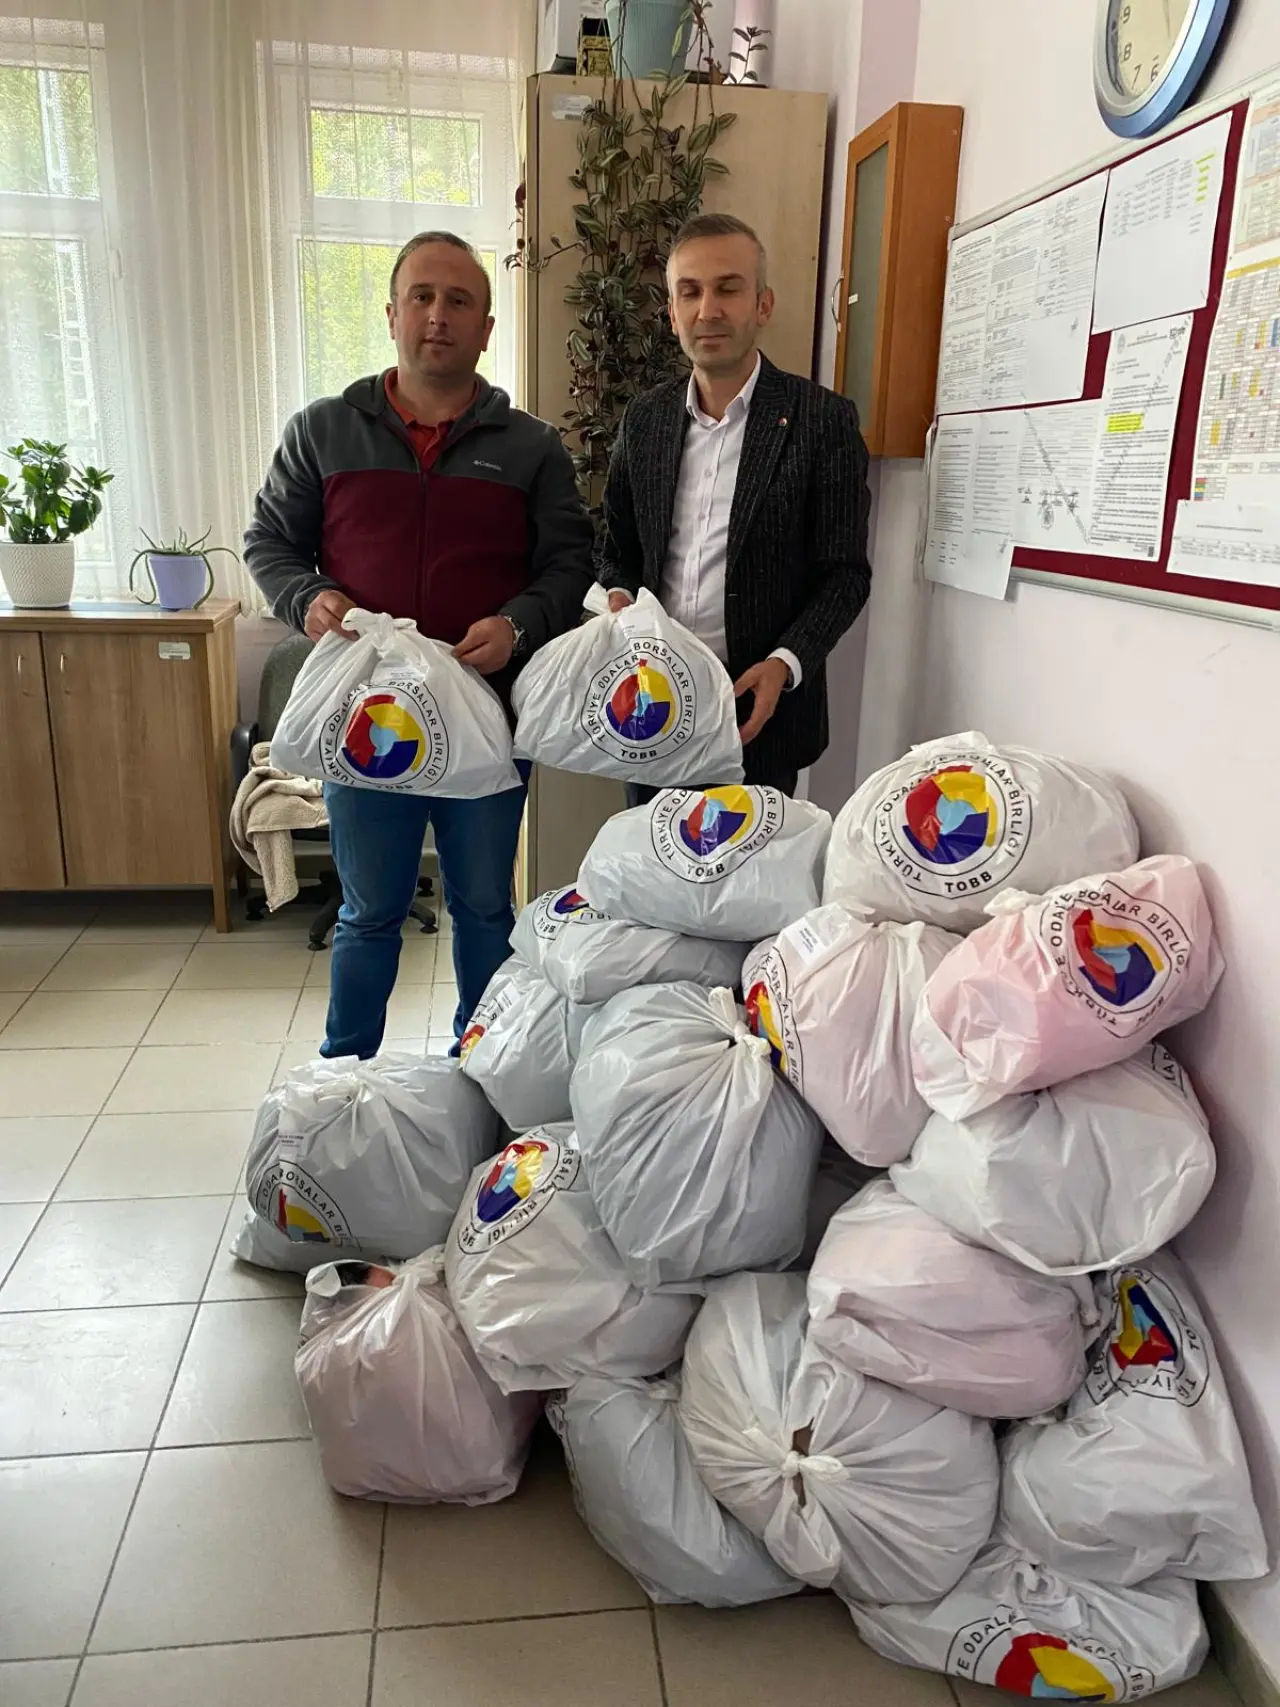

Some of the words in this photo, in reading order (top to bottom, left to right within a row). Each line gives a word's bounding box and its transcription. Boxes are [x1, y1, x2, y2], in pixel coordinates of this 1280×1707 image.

[1123, 5, 1131, 24] 9
[1123, 42, 1132, 62] 8
[1131, 63, 1142, 90] 7
[1150, 63, 1159, 81] 6
[597, 654, 639, 689] ODALAR
[633, 642, 690, 689] BORSALAR
[621, 749, 657, 759] TOBB
[687, 864, 725, 877] TOBB
[945, 871, 992, 893] TOBB
